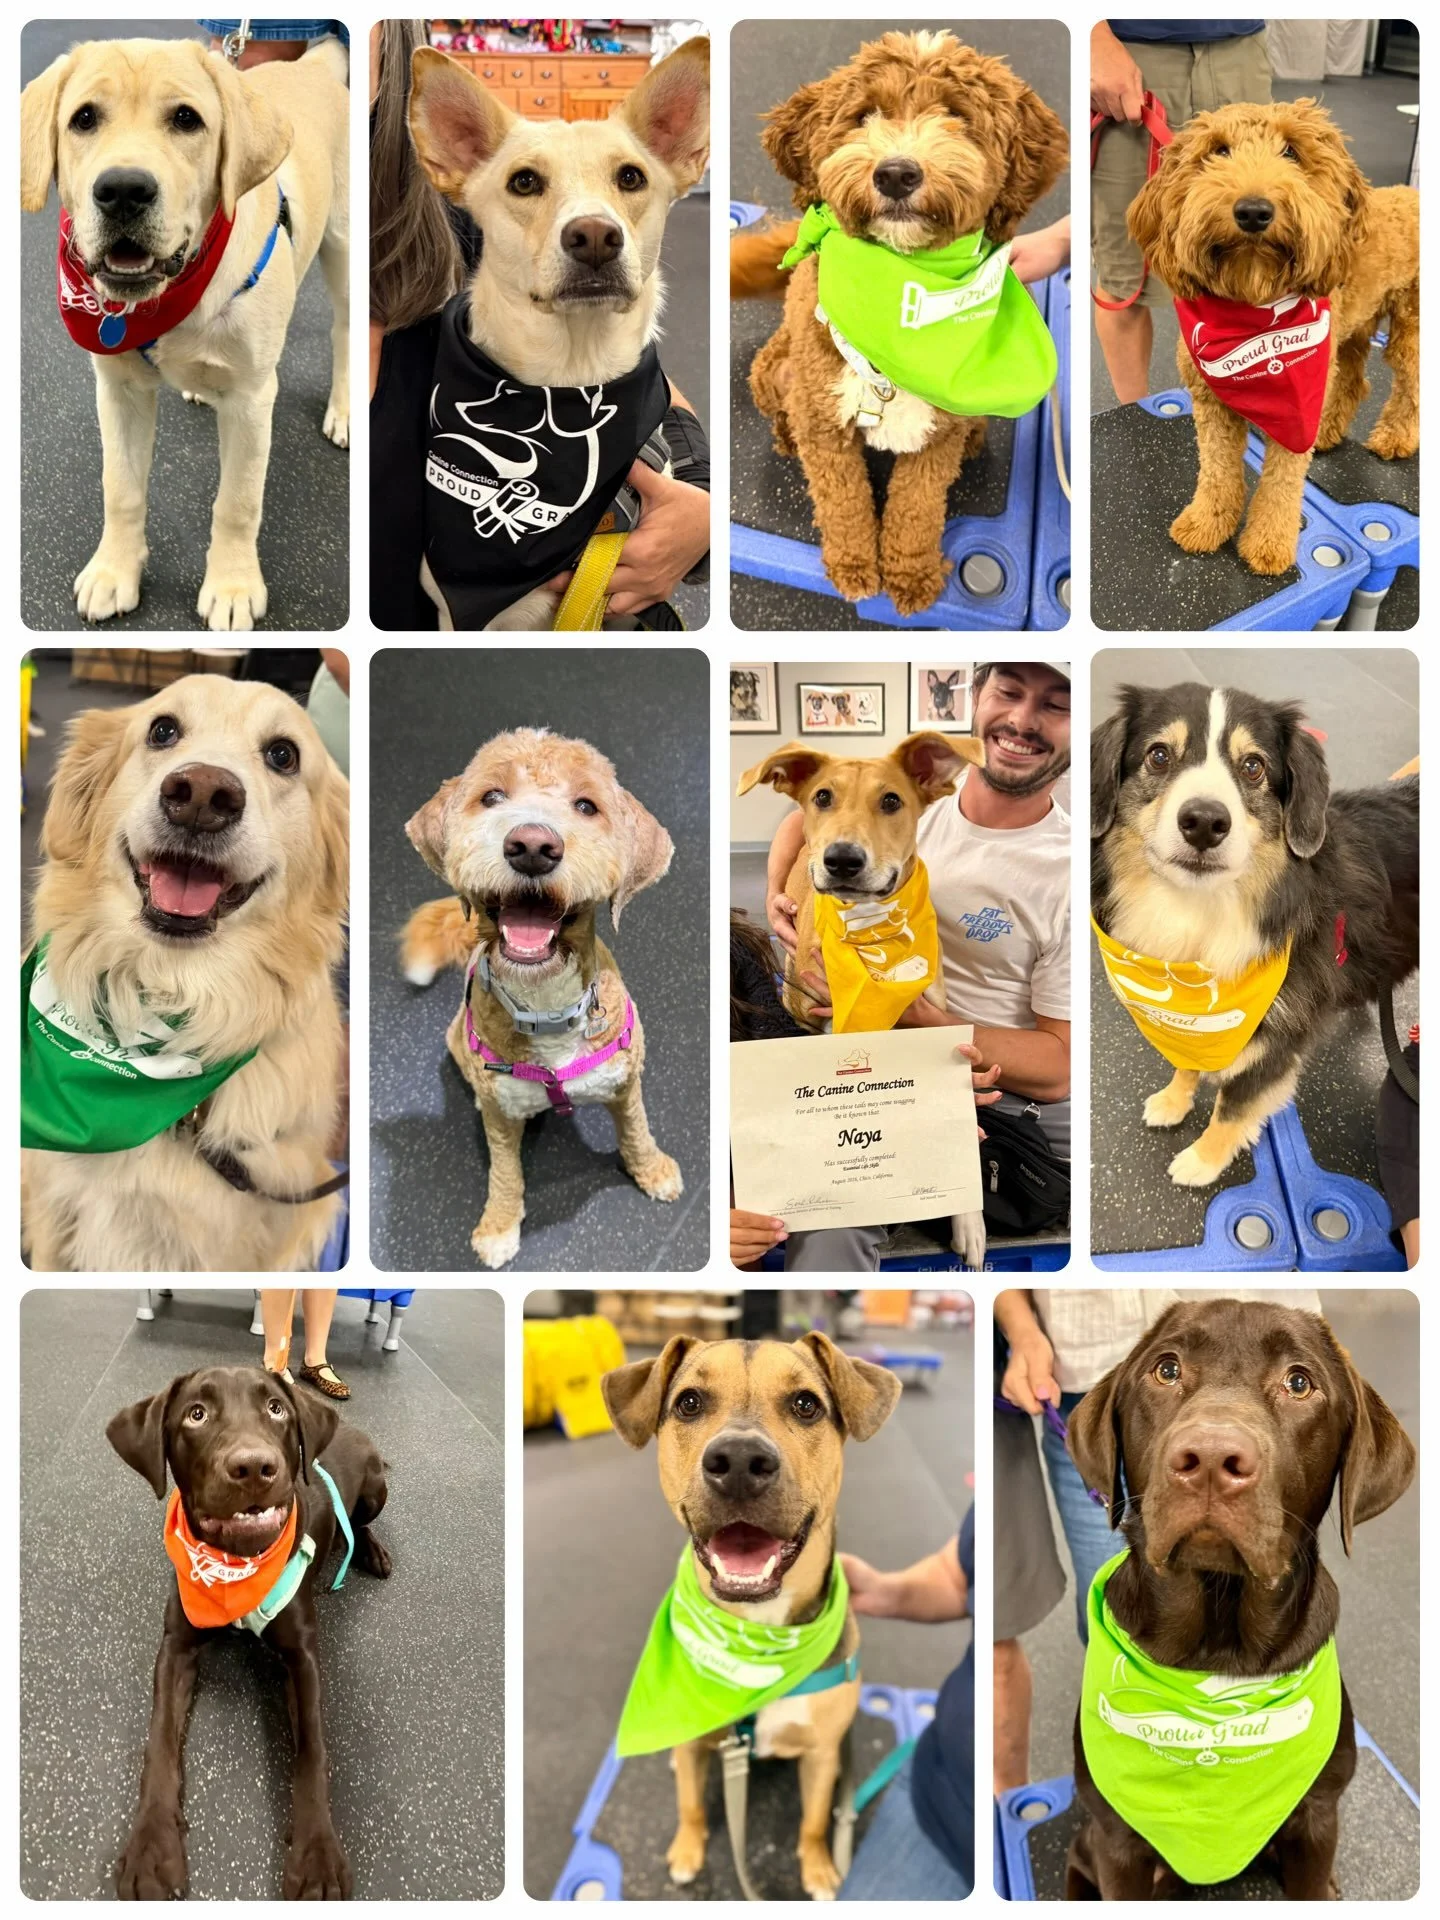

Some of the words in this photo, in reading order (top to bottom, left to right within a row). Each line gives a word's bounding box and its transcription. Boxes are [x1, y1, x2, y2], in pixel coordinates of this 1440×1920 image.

[1222, 339, 1268, 372] Proud
[1271, 327, 1311, 353] Grad
[1245, 370, 1267, 379] Canine
[1285, 347, 1318, 368] Connection
[428, 450, 450, 469] Canine
[450, 464, 499, 487] Connection
[429, 466, 481, 501] PROUD
[532, 507, 571, 523] GRA
[979, 907, 1006, 920] FAT
[965, 927, 999, 942] DROP
[36, 1019, 48, 1035] The
[794, 1086, 815, 1099] The
[817, 1083, 855, 1098] Canine
[857, 1077, 915, 1094] Connection
[837, 1127, 883, 1149] Naya
[823, 1160, 836, 1168] Has
[836, 1154, 868, 1166] successfully
[1211, 1715, 1270, 1745] Grad
[1163, 1751, 1194, 1767] Canine
[1222, 1747, 1274, 1765] Connection
